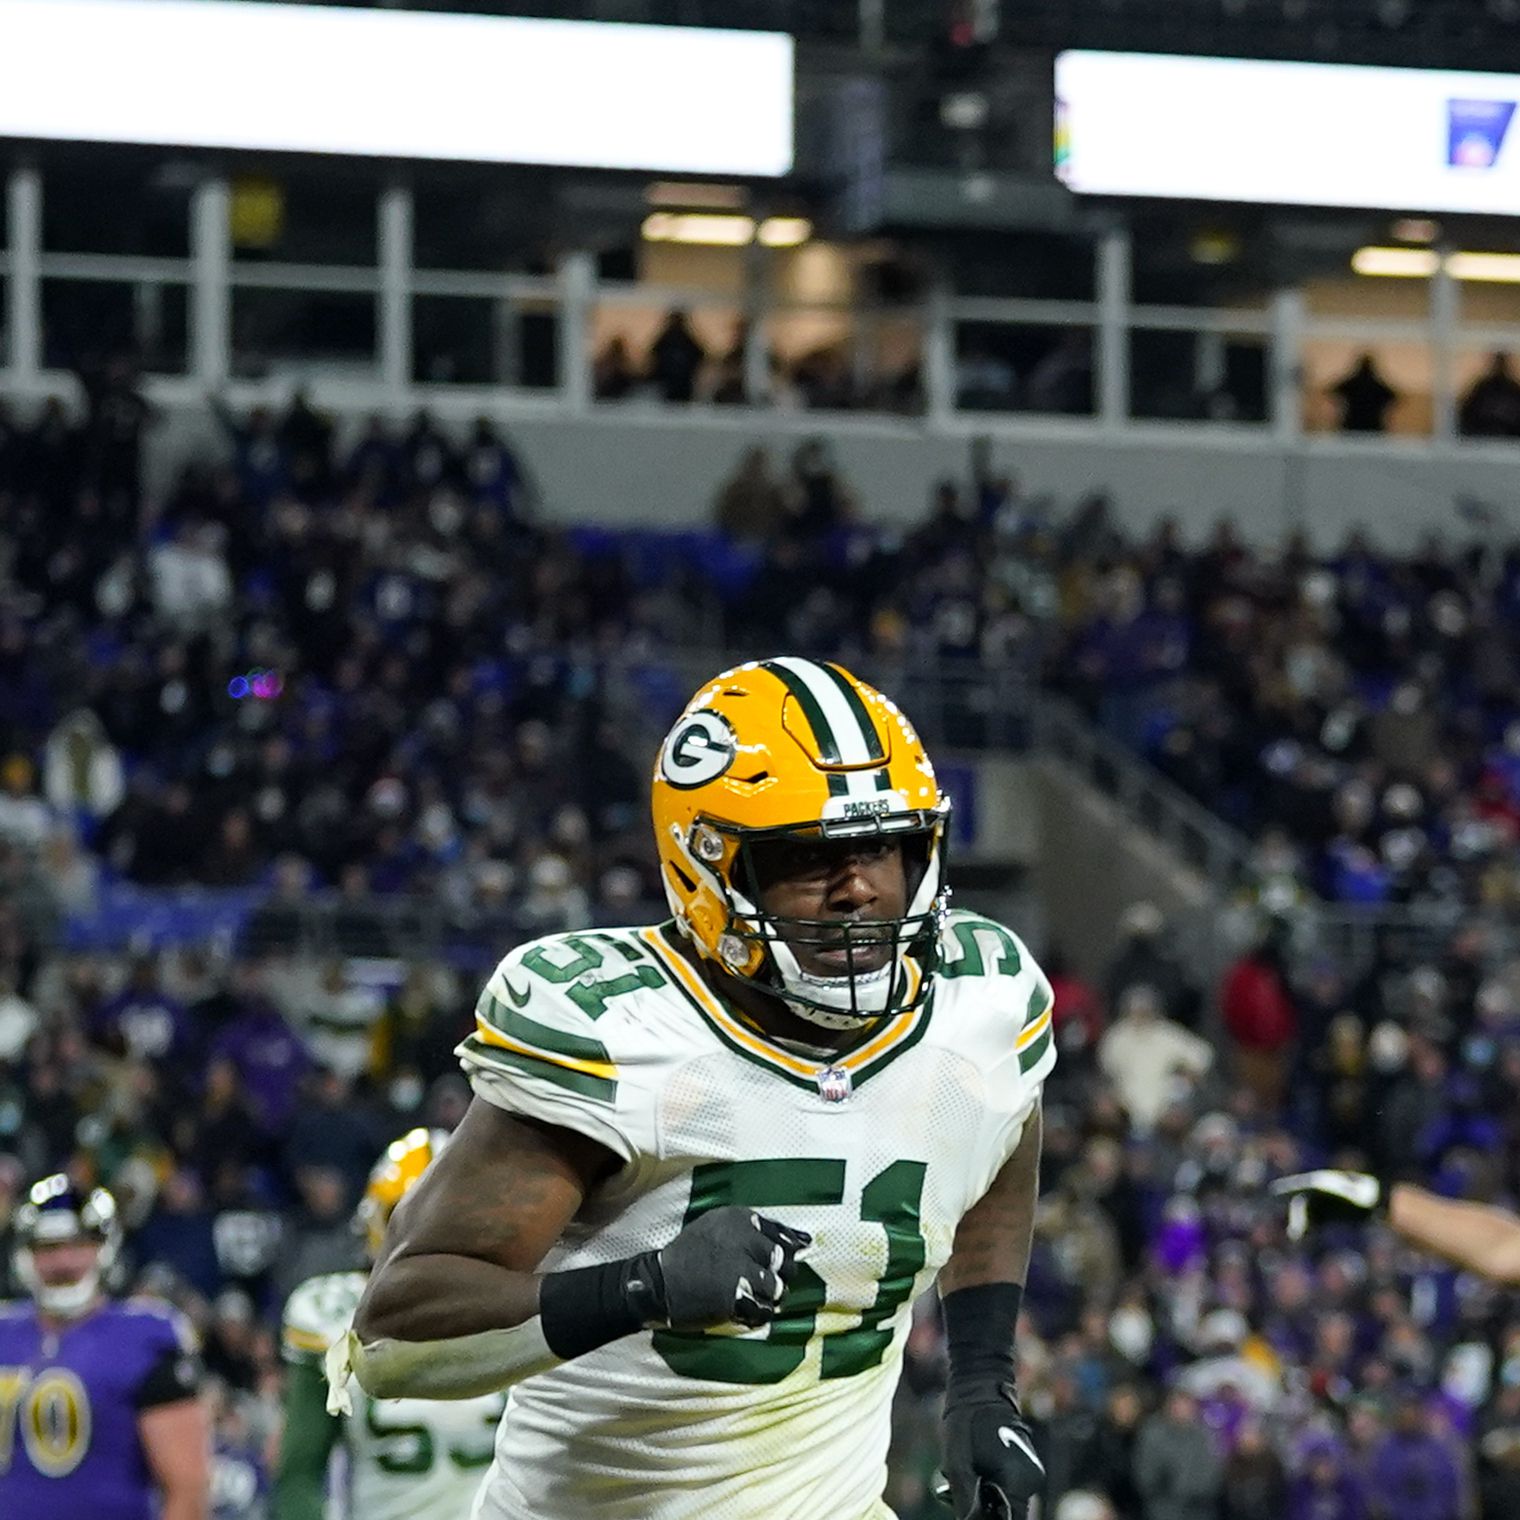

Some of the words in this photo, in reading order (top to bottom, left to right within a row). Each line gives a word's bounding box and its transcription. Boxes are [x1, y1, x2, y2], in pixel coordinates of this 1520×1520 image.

[661, 708, 736, 791] G
[843, 799, 889, 816] PACKERS
[650, 1157, 928, 1385] 51
